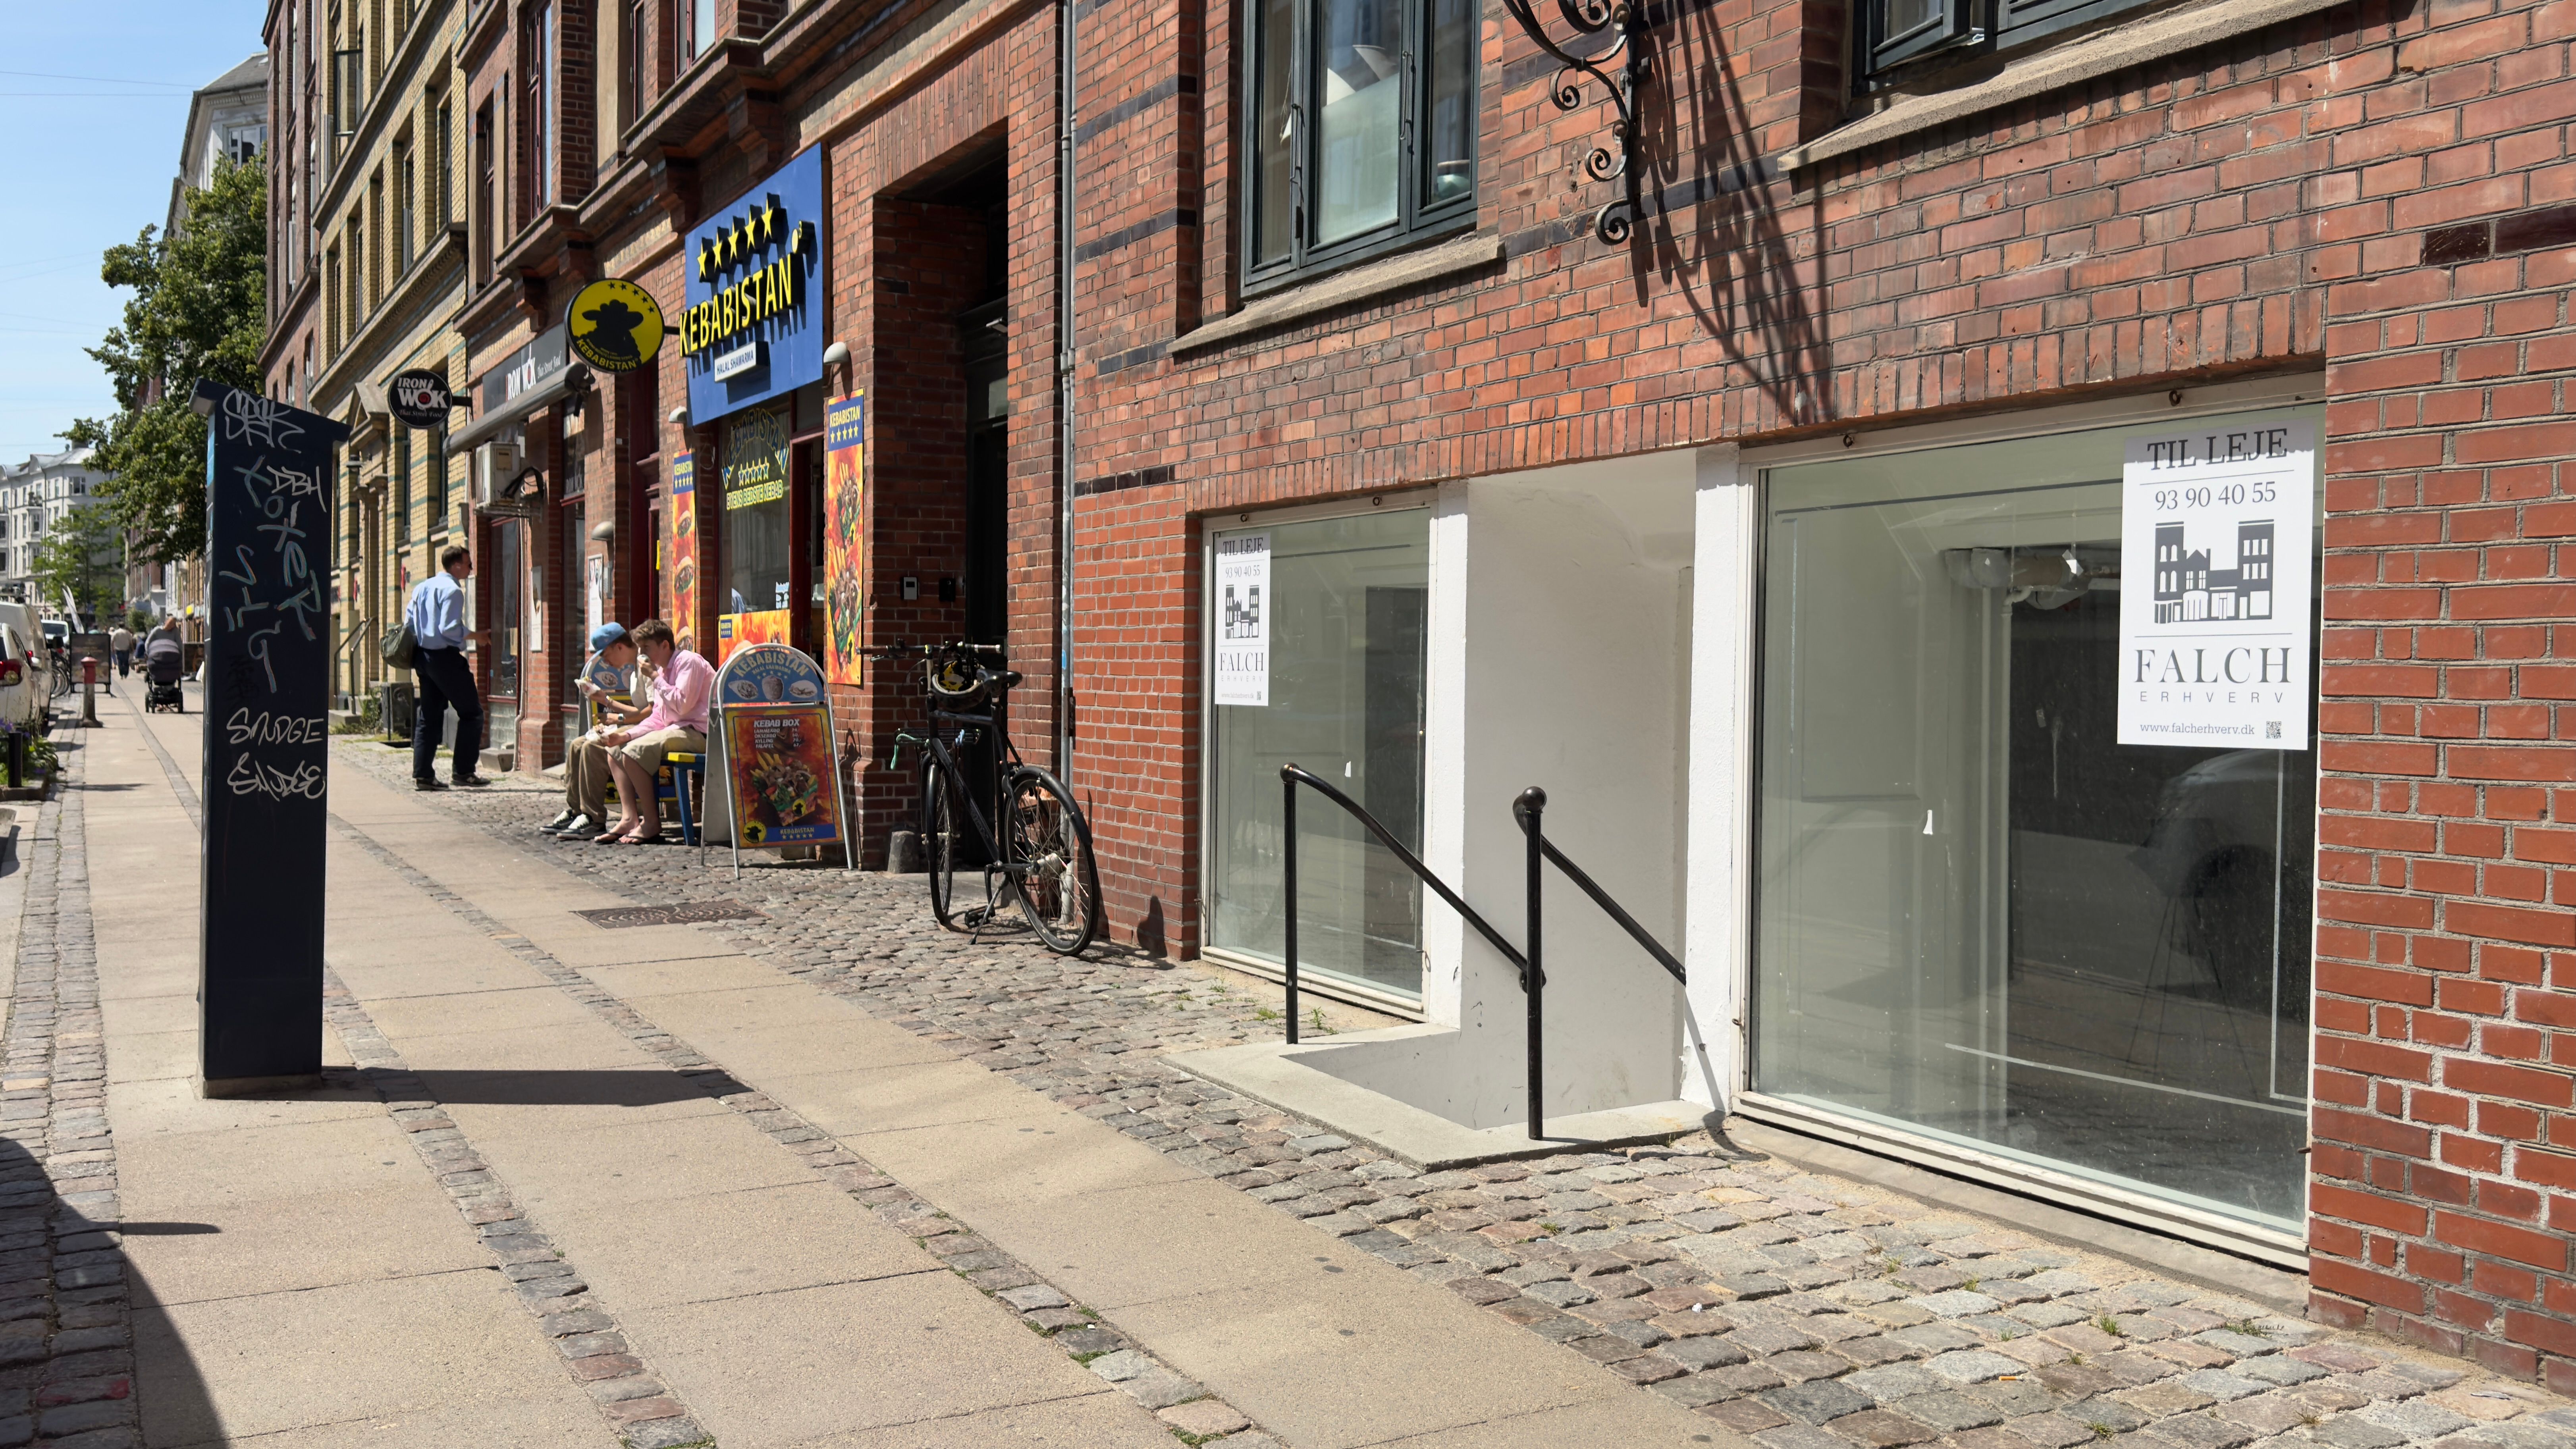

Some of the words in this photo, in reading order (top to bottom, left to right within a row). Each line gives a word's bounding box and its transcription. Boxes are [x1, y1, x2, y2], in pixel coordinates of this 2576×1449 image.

[679, 253, 792, 357] KEBABISTAN
[577, 338, 637, 370] KEBABISTAN
[717, 360, 730, 375] HALAL
[731, 349, 754, 370] SHAWARMA
[397, 377, 427, 388] IRON
[505, 366, 521, 403] IRON
[522, 349, 536, 391] WOK
[397, 387, 448, 410] WOK
[830, 405, 860, 428] KEBABISTAN
[2147, 439, 2196, 470] TIL
[2206, 428, 2287, 465] LEJE
[727, 489, 743, 510] BYENS
[743, 484, 763, 506] BEDSTE
[764, 479, 783, 501] KEBAB
[2155, 490, 2178, 511] 93
[2186, 487, 2210, 508] 90
[2218, 484, 2244, 505] 40
[2252, 481, 2276, 503] 55
[1223, 540, 1238, 556] TIL
[1240, 537, 1263, 555] LEJE
[1226, 567, 1232, 578] 93
[1234, 566, 1242, 577] 90
[1244, 565, 1251, 576] 40
[1253, 565, 1260, 576] 55
[734, 651, 809, 677] KEBABISTAN
[1220, 652, 1264, 672] FALCH
[2134, 647, 2292, 684] FALCH
[2140, 691, 2283, 703] ERHVERV
[2140, 723, 2255, 735] www.falcherhverv.dk
